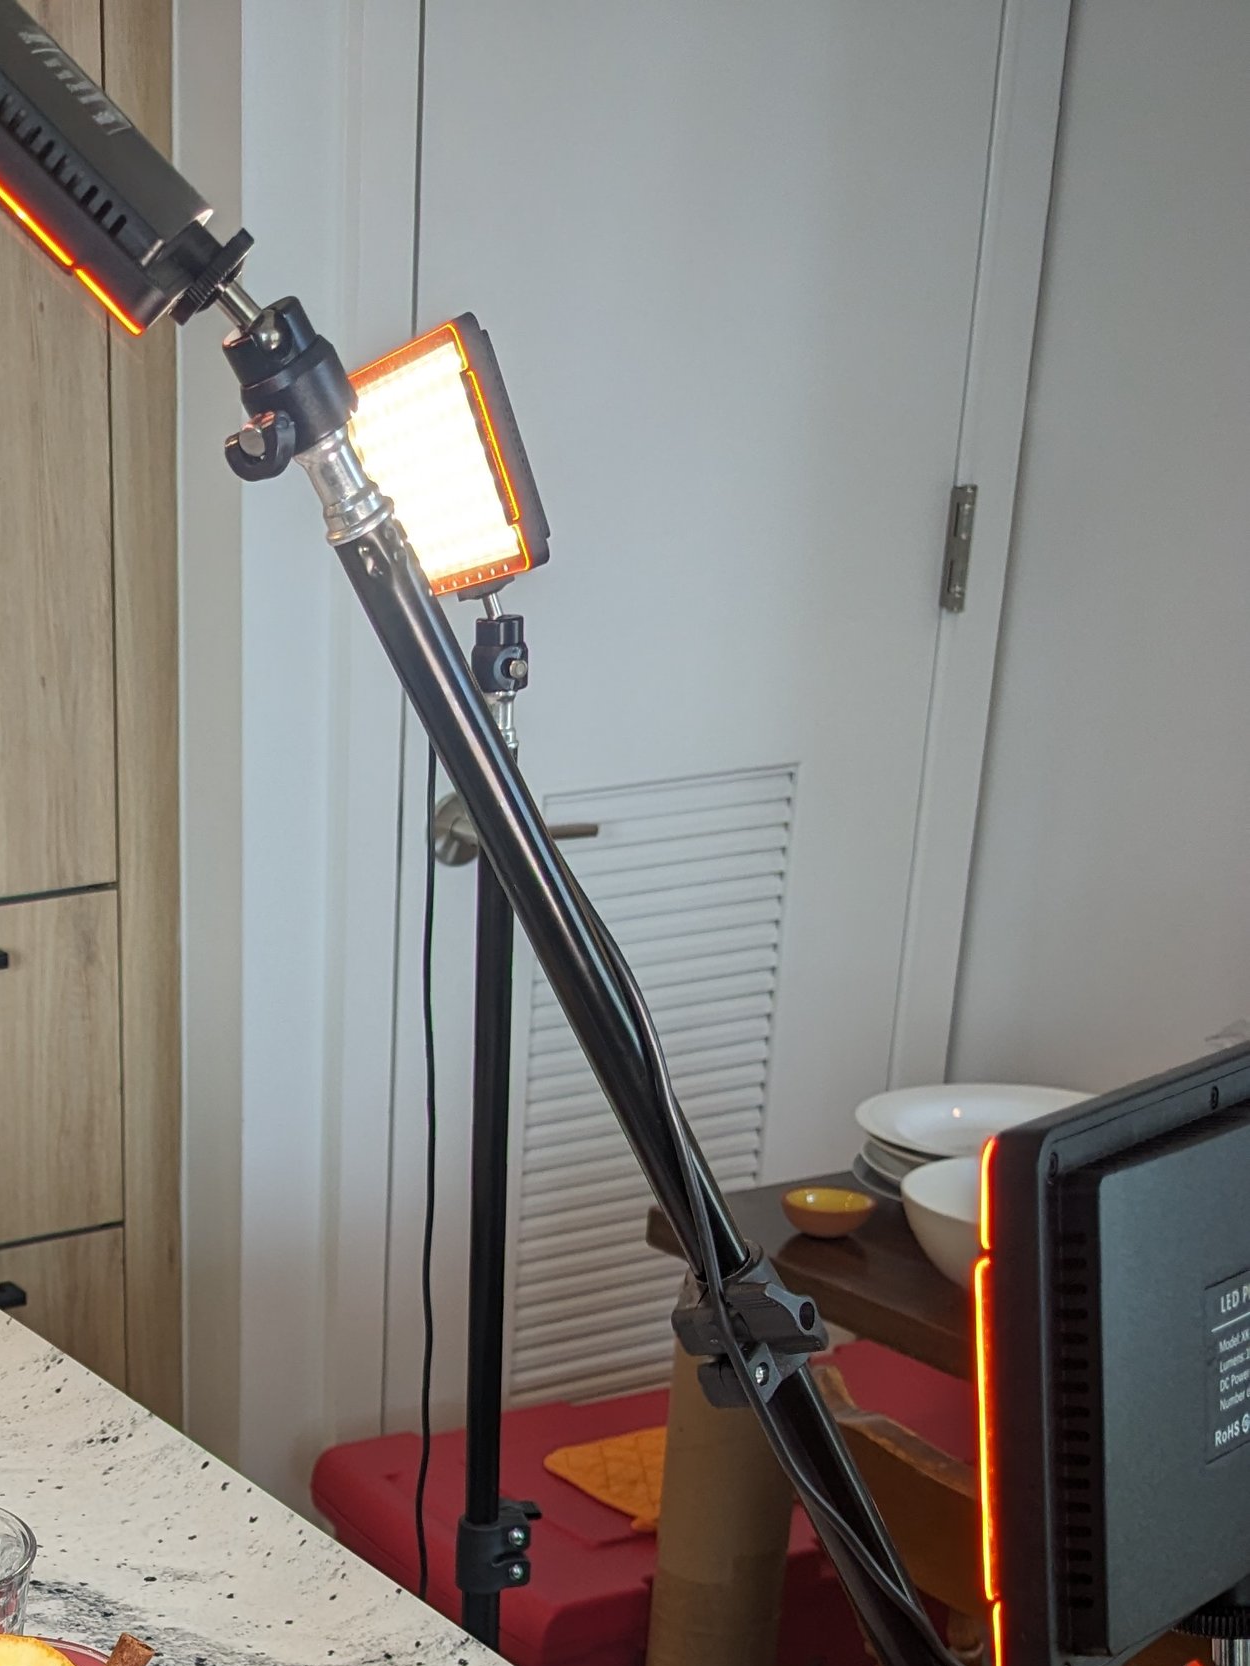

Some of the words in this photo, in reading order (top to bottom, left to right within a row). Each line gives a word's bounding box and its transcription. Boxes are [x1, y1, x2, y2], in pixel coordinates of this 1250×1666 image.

[1220, 1289, 1240, 1313] LED
[1219, 1377, 1231, 1393] DC
[1215, 1420, 1241, 1446] RoHS
